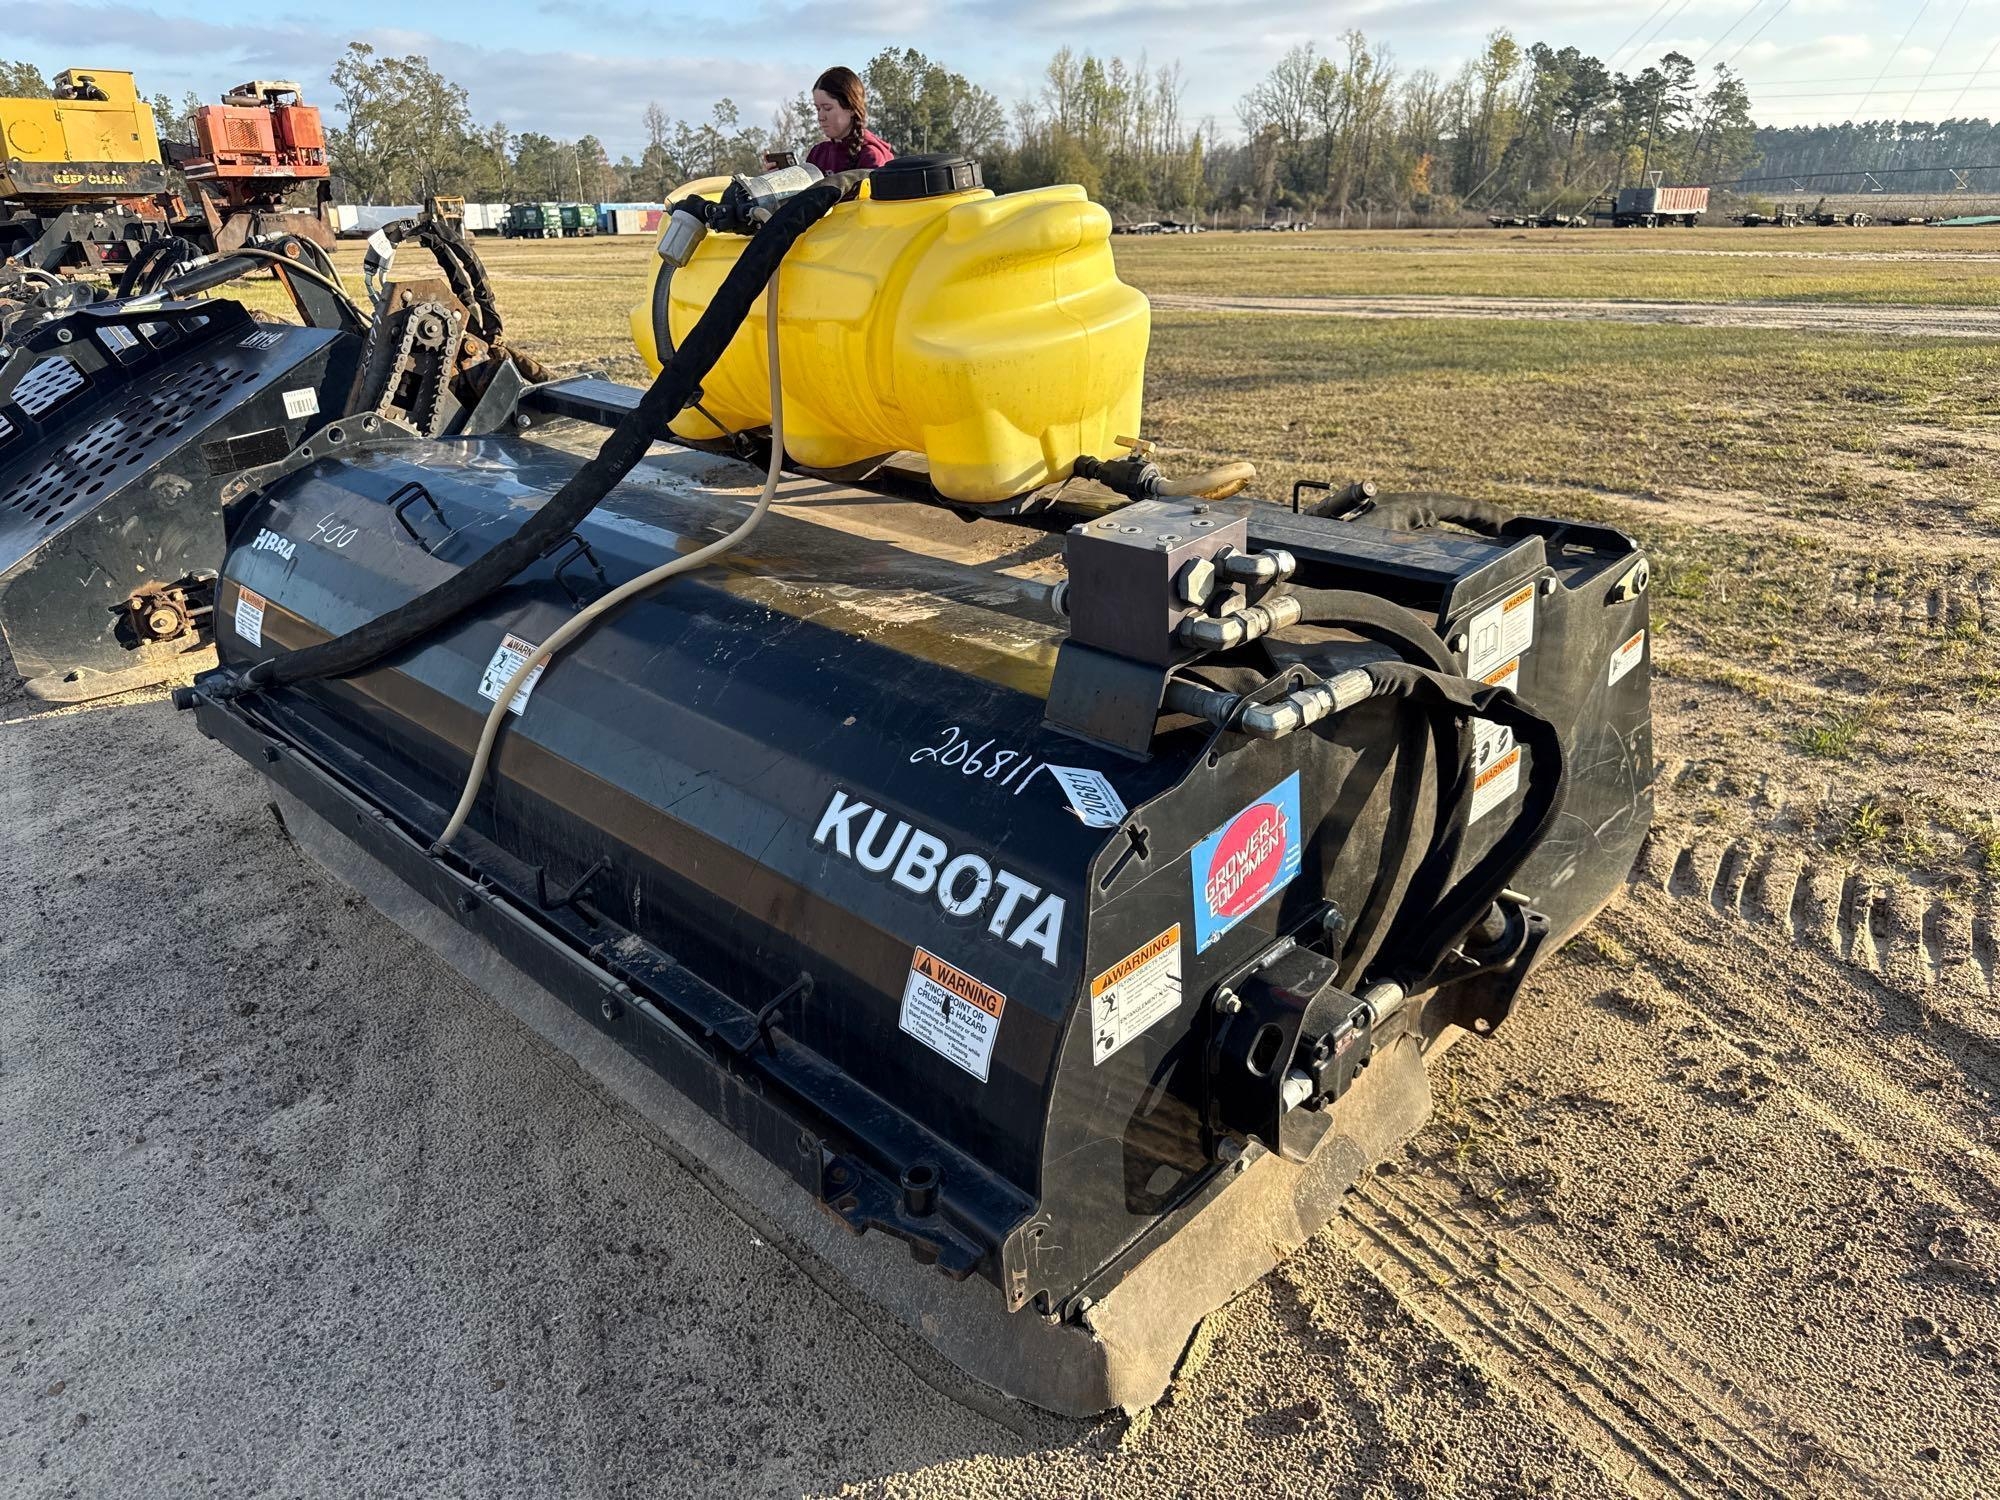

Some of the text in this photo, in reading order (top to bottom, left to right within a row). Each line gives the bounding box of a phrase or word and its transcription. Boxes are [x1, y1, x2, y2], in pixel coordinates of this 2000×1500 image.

[53, 174, 127, 185] KEEP CLEAR
[308, 512, 359, 548] 400
[910, 726, 1045, 795] 206811
[1482, 752, 1515, 784] WARNING
[1063, 772, 1112, 818] 206811
[1205, 801, 1285, 904] GROWERS
[1209, 816, 1290, 919] EQUIPMENT
[813, 790, 1066, 967] KUBOTA
[1112, 933, 1169, 982] WARNING
[917, 986, 987, 1035] CRUSHG HAZARD
[924, 980, 984, 1022] PINCH POINT OR
[935, 964, 997, 1013] WARNING
